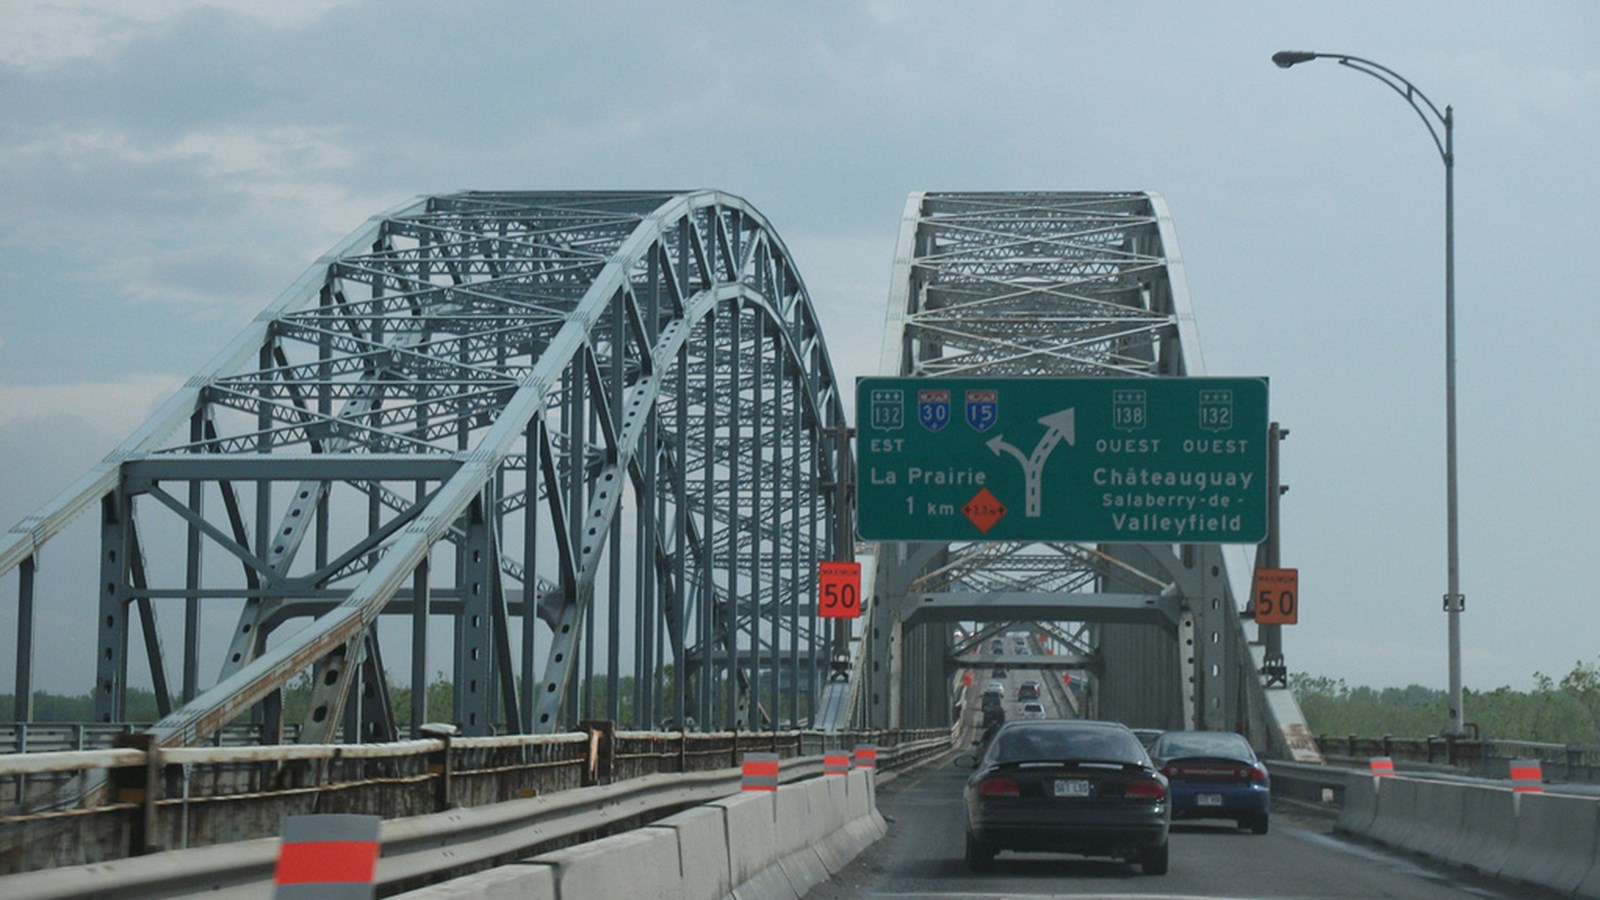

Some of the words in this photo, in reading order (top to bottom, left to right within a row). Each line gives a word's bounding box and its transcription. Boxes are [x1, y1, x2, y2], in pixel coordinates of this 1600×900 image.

[874, 407, 900, 423] 132
[923, 404, 946, 421] 30
[971, 405, 993, 421] 15
[1116, 407, 1143, 424] 138
[1202, 407, 1229, 424] 132
[870, 438, 905, 452] EST
[1095, 439, 1161, 453] OUEST
[1182, 439, 1249, 454] OUEST
[870, 467, 897, 485] La
[907, 467, 987, 485] Prairie
[1093, 467, 1253, 491] Châteauguay
[906, 496, 915, 515] 1
[927, 502, 955, 516] km
[1111, 512, 1242, 536] Valleyfield
[824, 583, 856, 609] 50
[1259, 590, 1294, 616] 50
